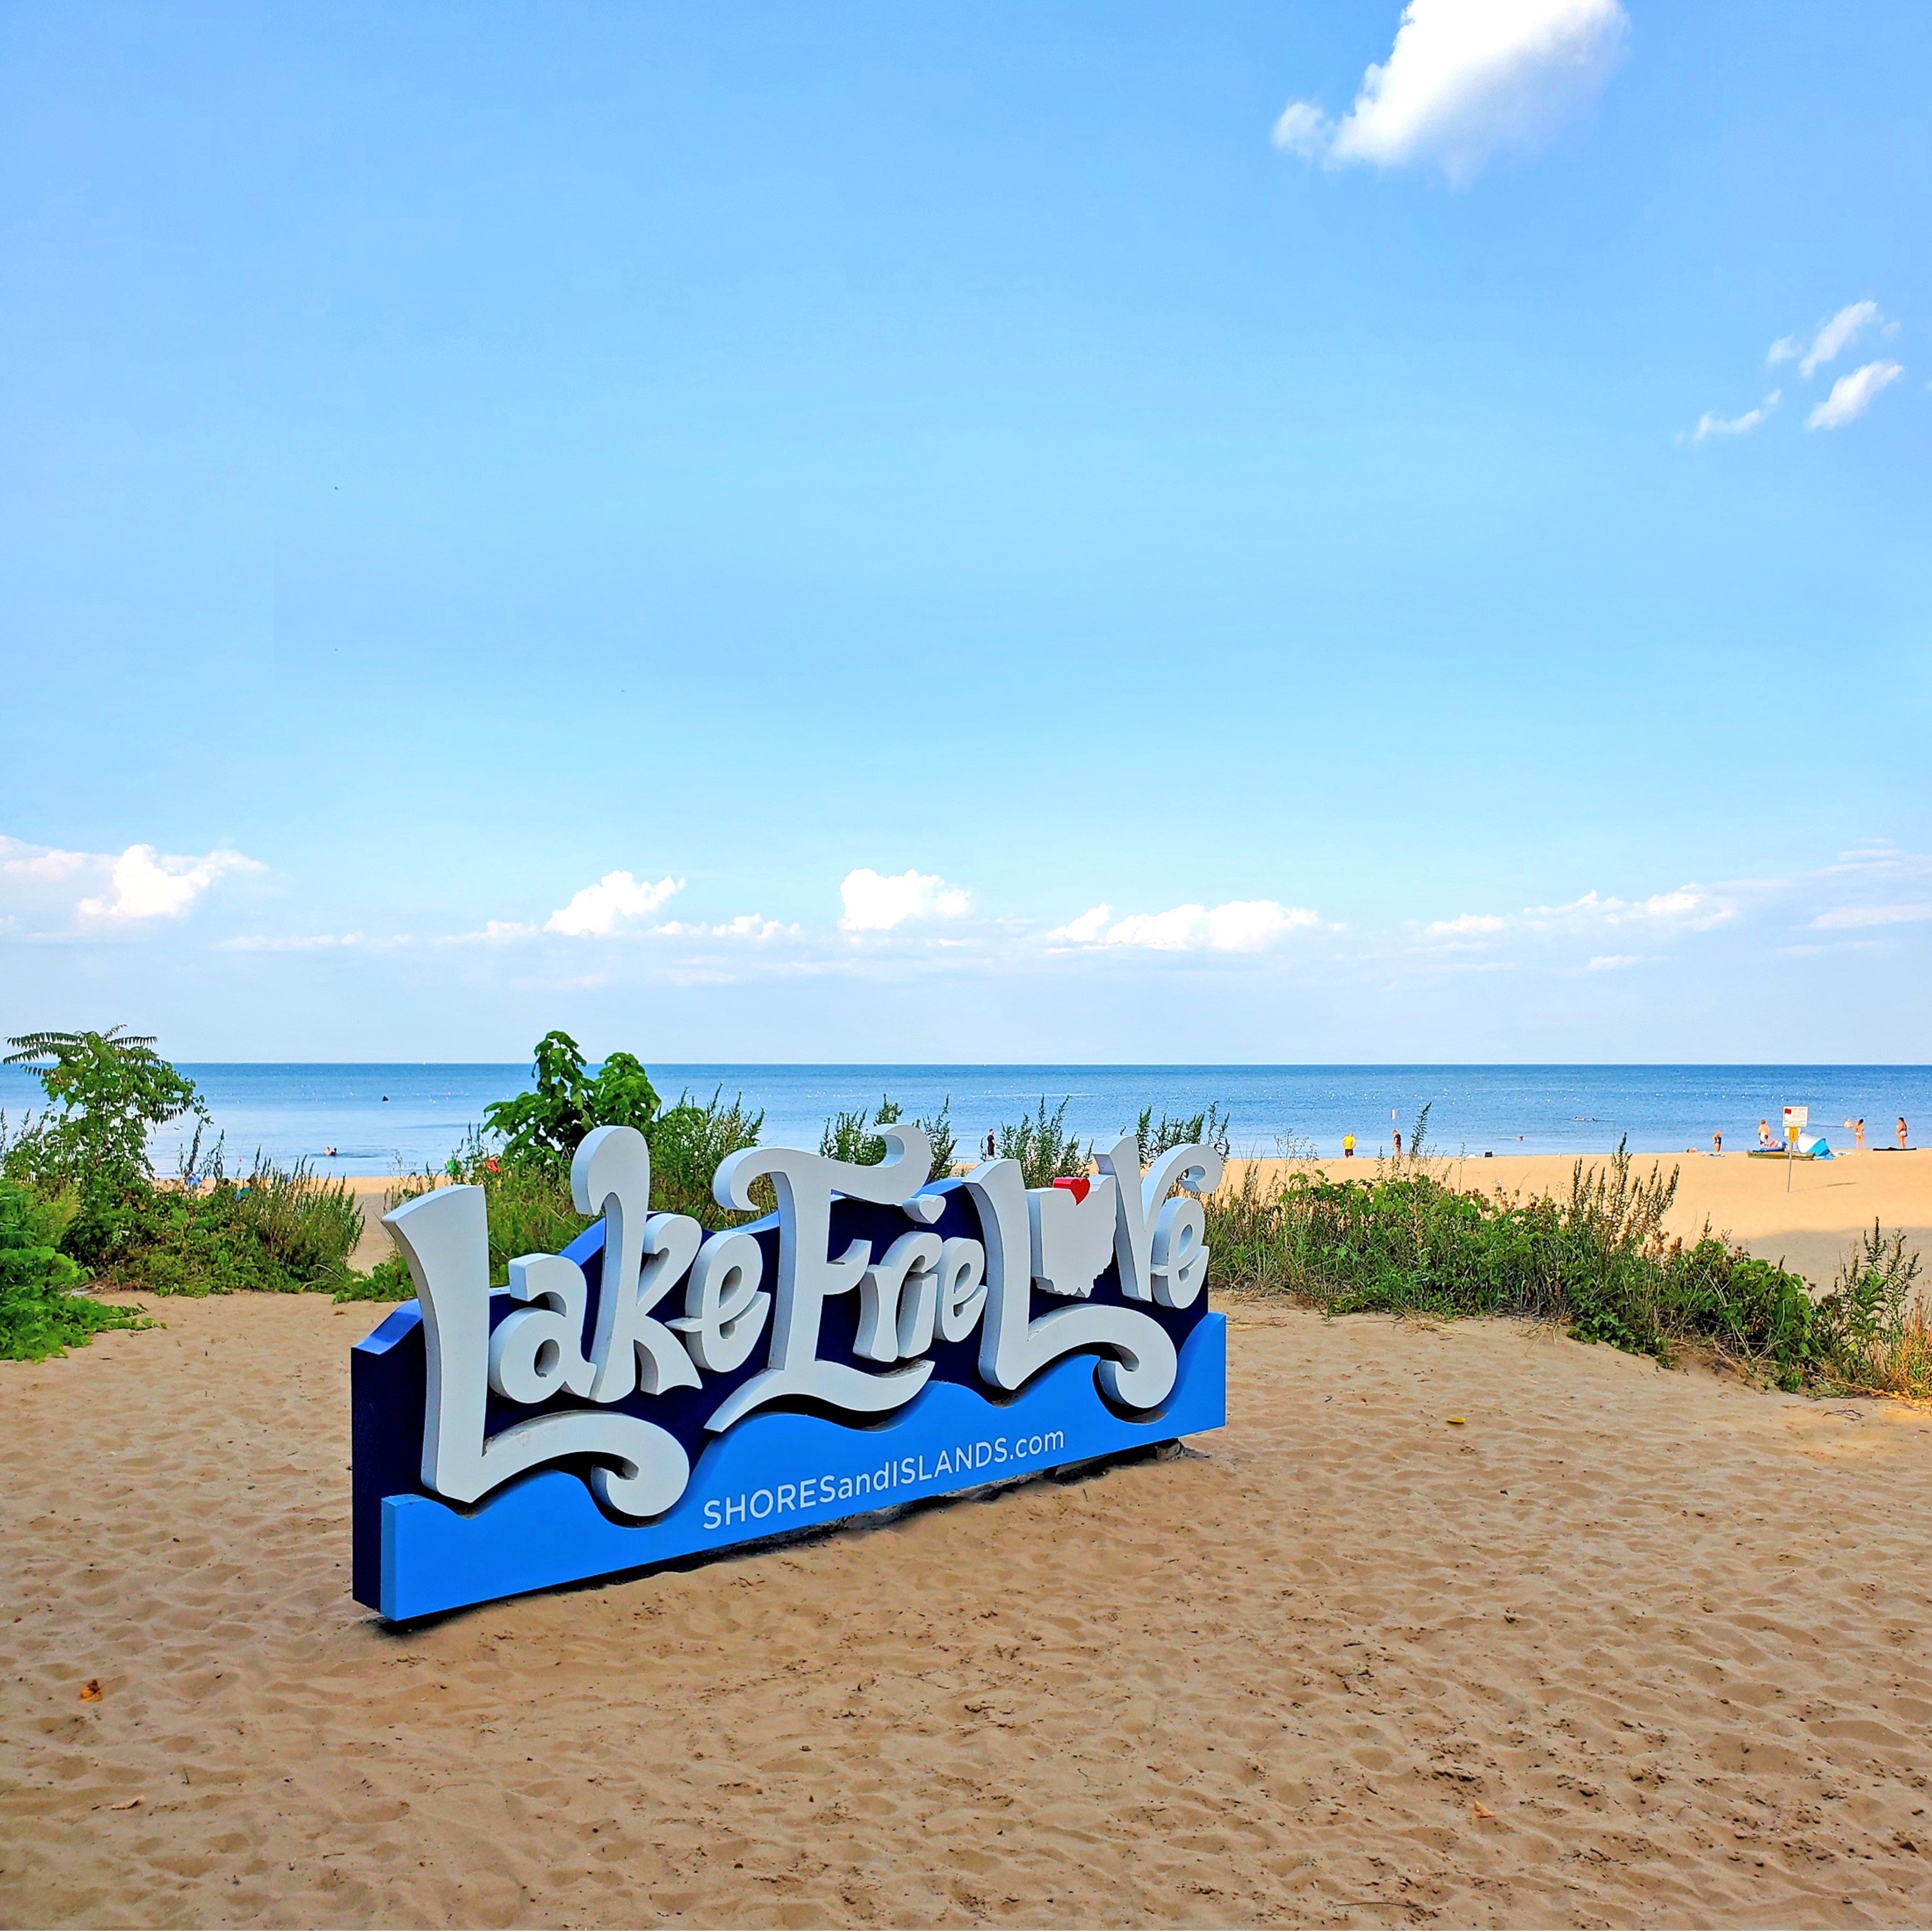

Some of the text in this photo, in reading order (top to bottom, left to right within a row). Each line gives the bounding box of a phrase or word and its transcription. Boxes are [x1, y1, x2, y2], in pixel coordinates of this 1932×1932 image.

[383, 1126, 770, 1517] Lake
[705, 1124, 987, 1431] Erie
[703, 1428, 1065, 1530] SHORESandISLANDS.com
